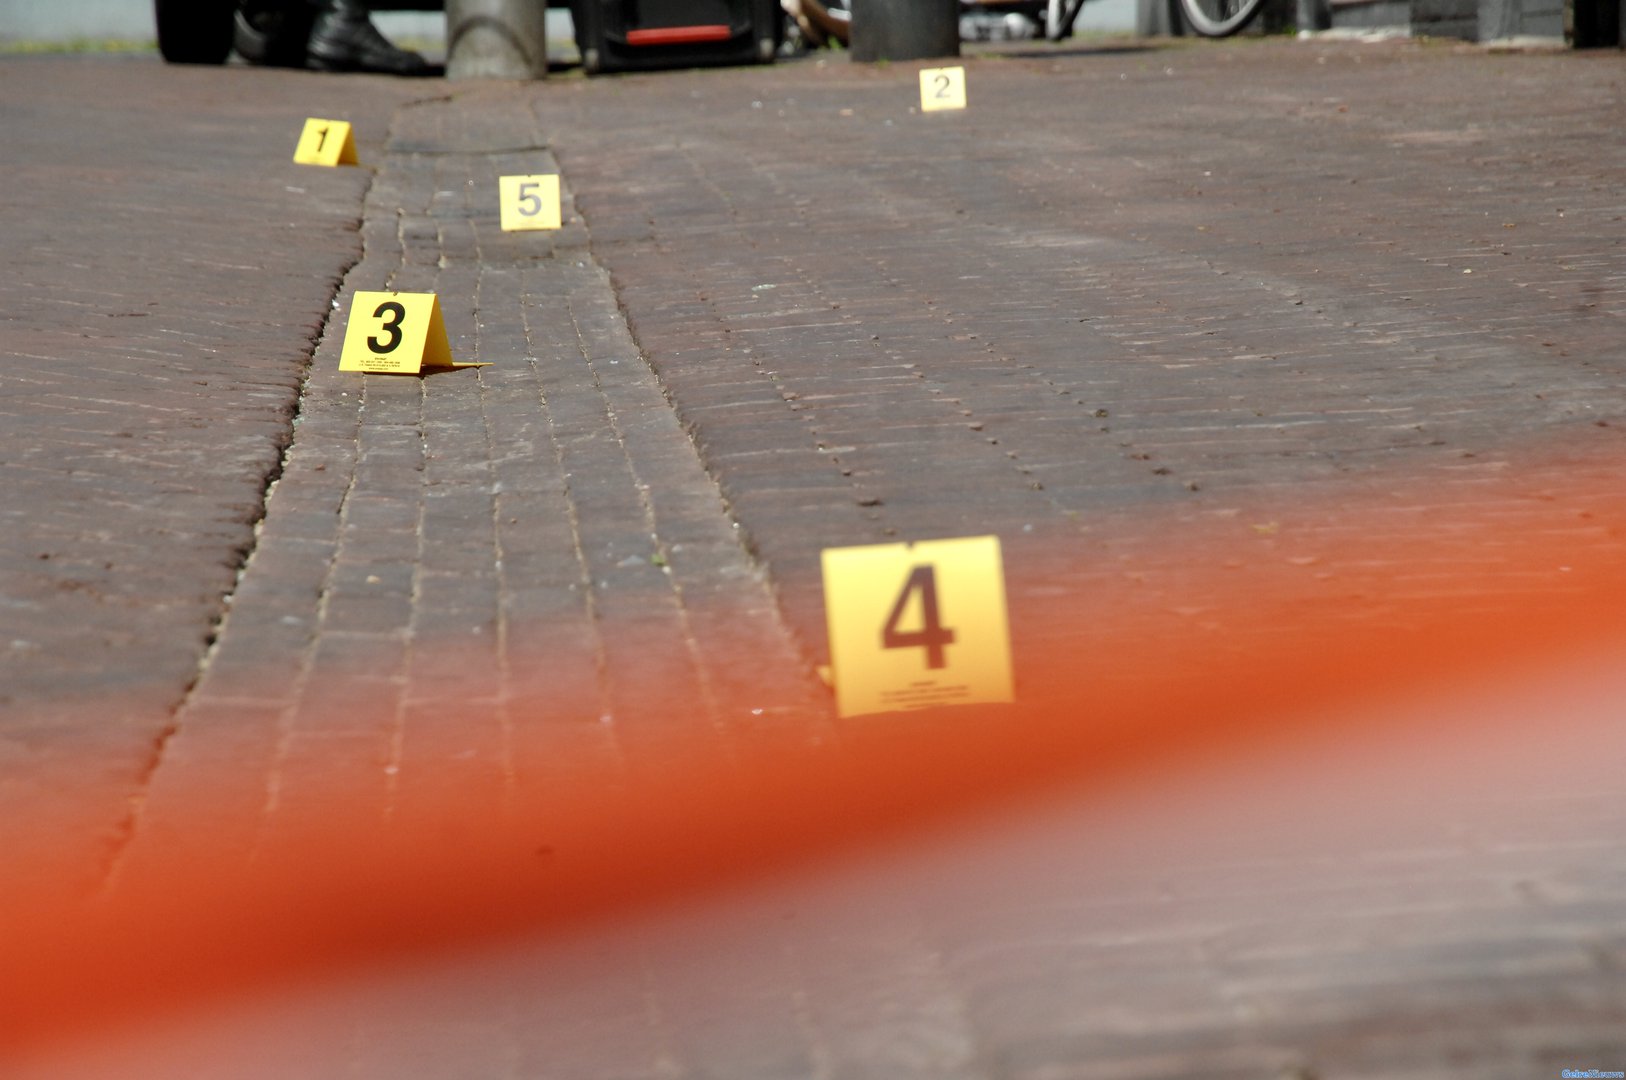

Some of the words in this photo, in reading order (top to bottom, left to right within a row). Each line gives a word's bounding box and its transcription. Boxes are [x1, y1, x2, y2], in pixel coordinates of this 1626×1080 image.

[934, 74, 951, 98] 2
[317, 127, 329, 153] 1
[518, 183, 542, 217] 5
[367, 301, 406, 354] 3
[882, 565, 956, 669] 4
